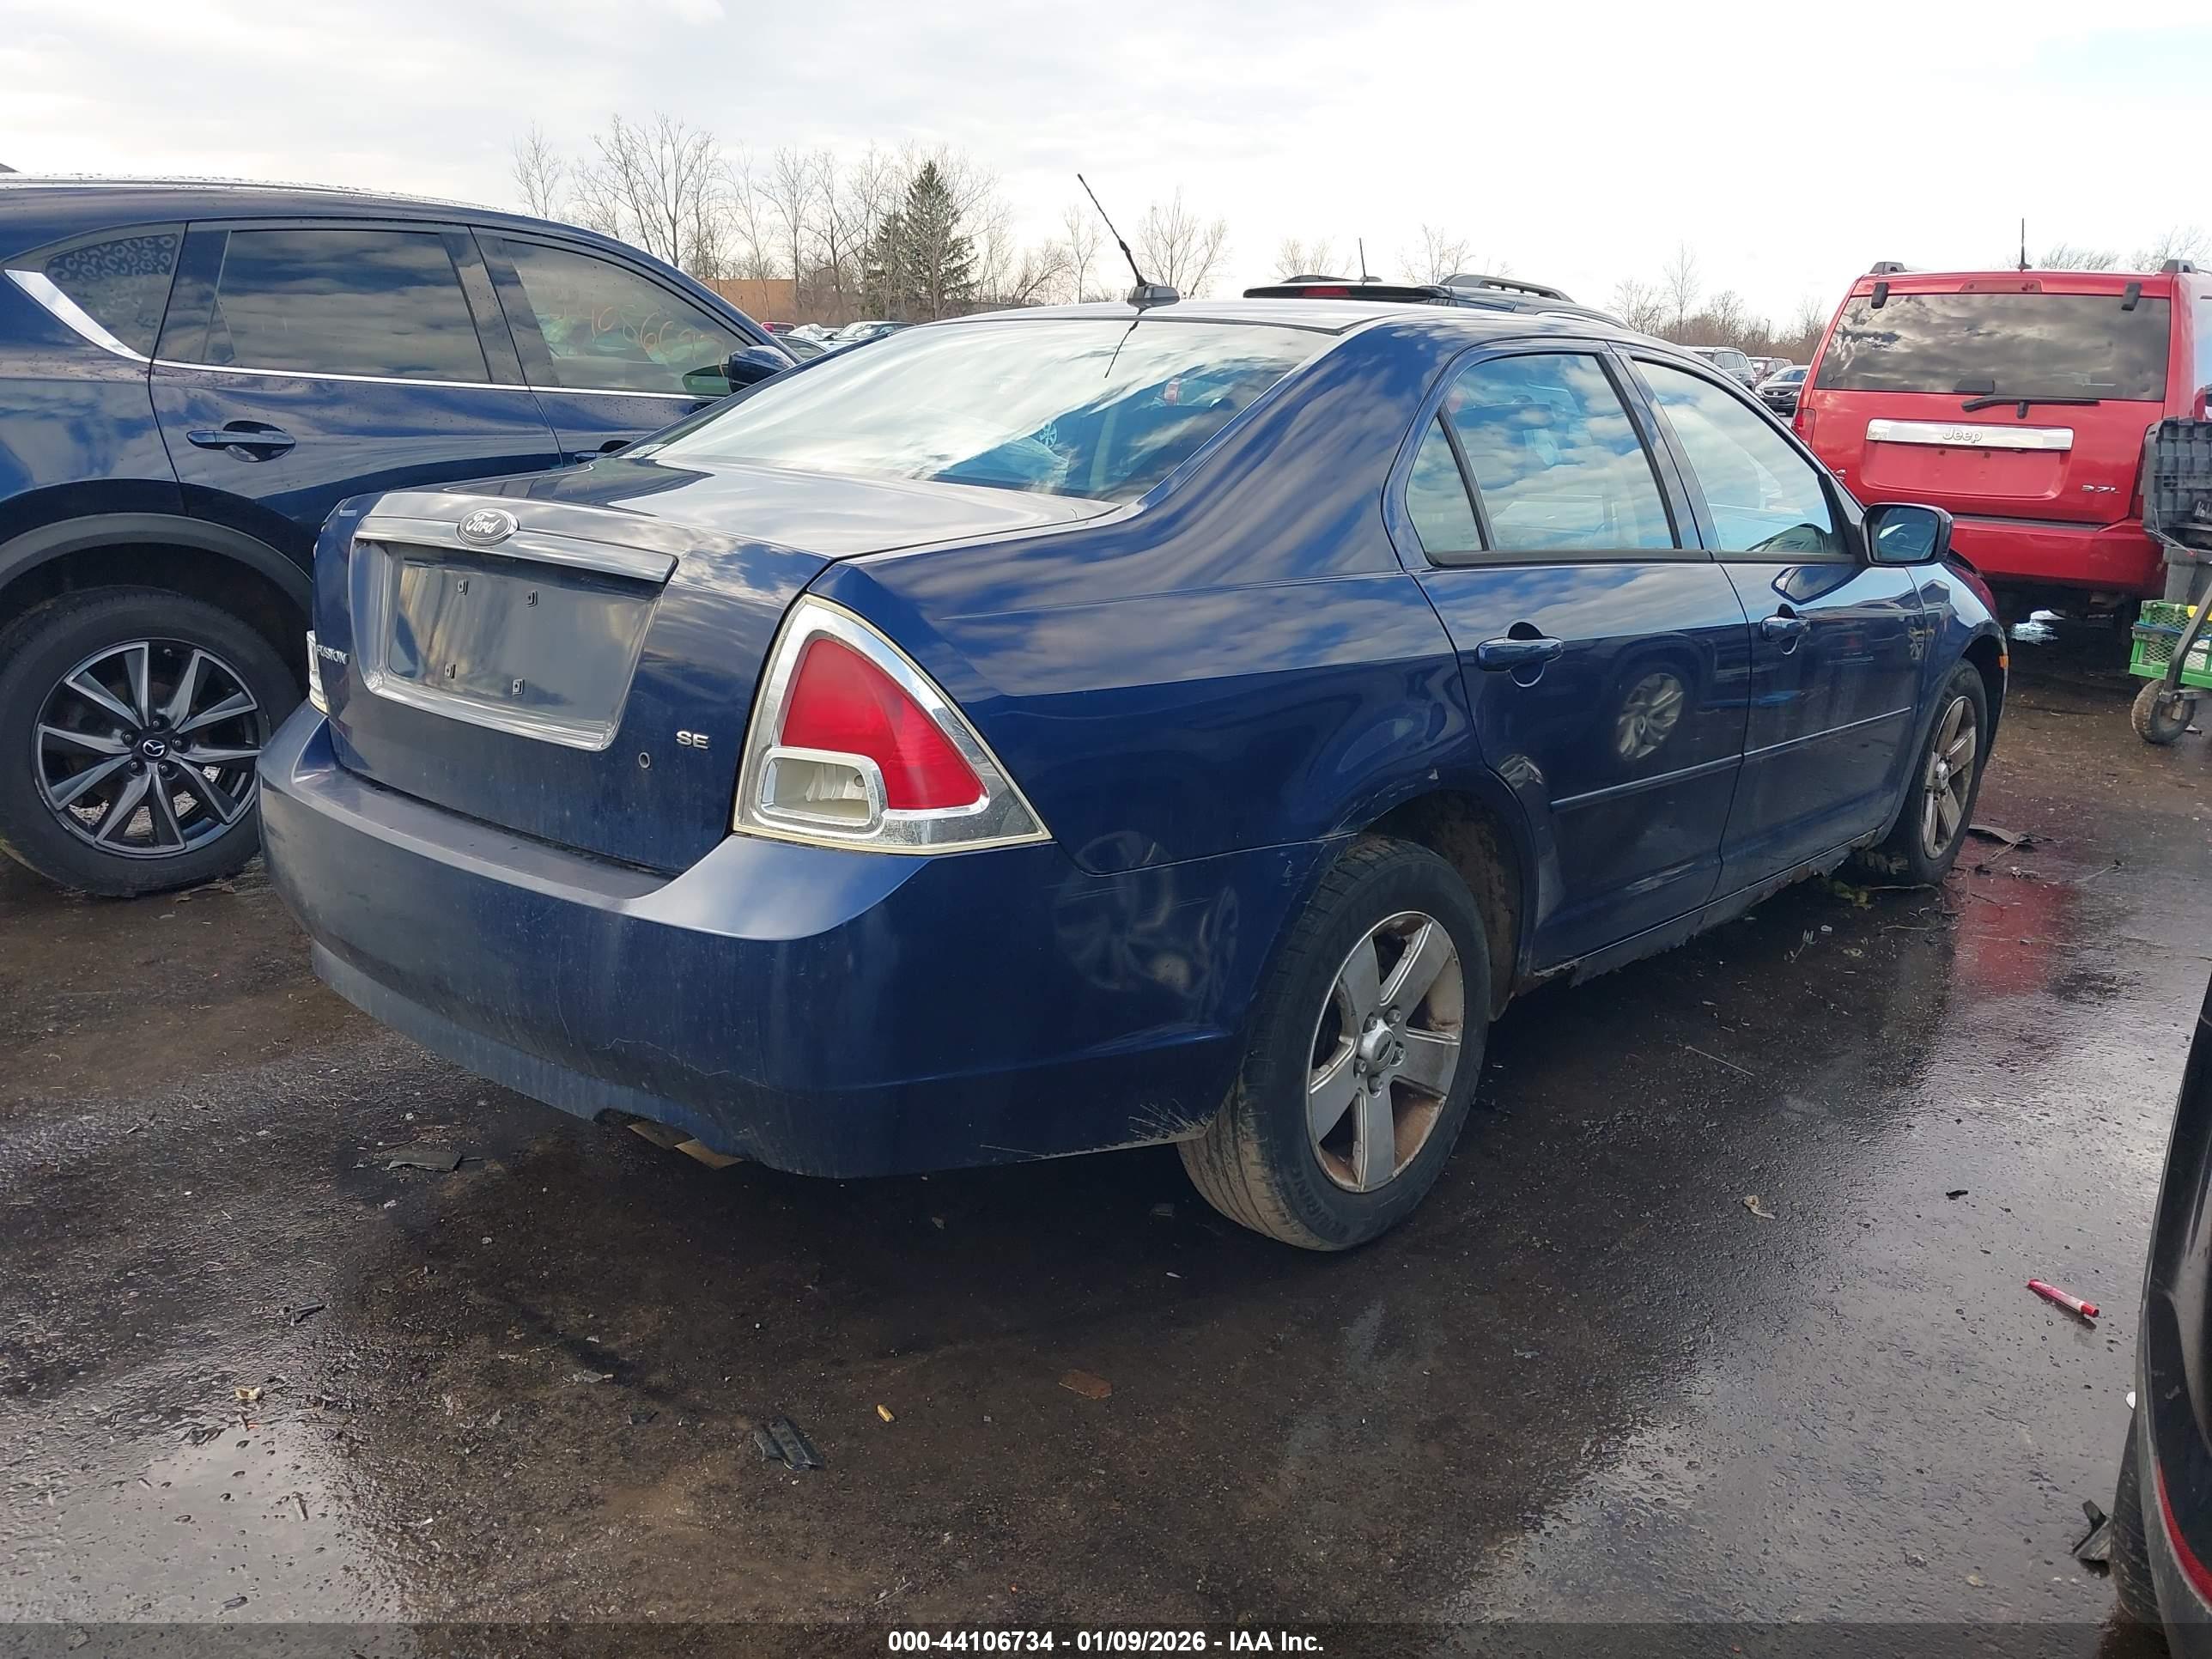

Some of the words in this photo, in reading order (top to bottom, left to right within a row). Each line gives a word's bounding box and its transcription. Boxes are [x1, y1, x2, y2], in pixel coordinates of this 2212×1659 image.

[1942, 427, 1983, 444] Jeep
[466, 512, 501, 534] Ford
[316, 644, 349, 665] FUSION
[676, 731, 709, 750] SE
